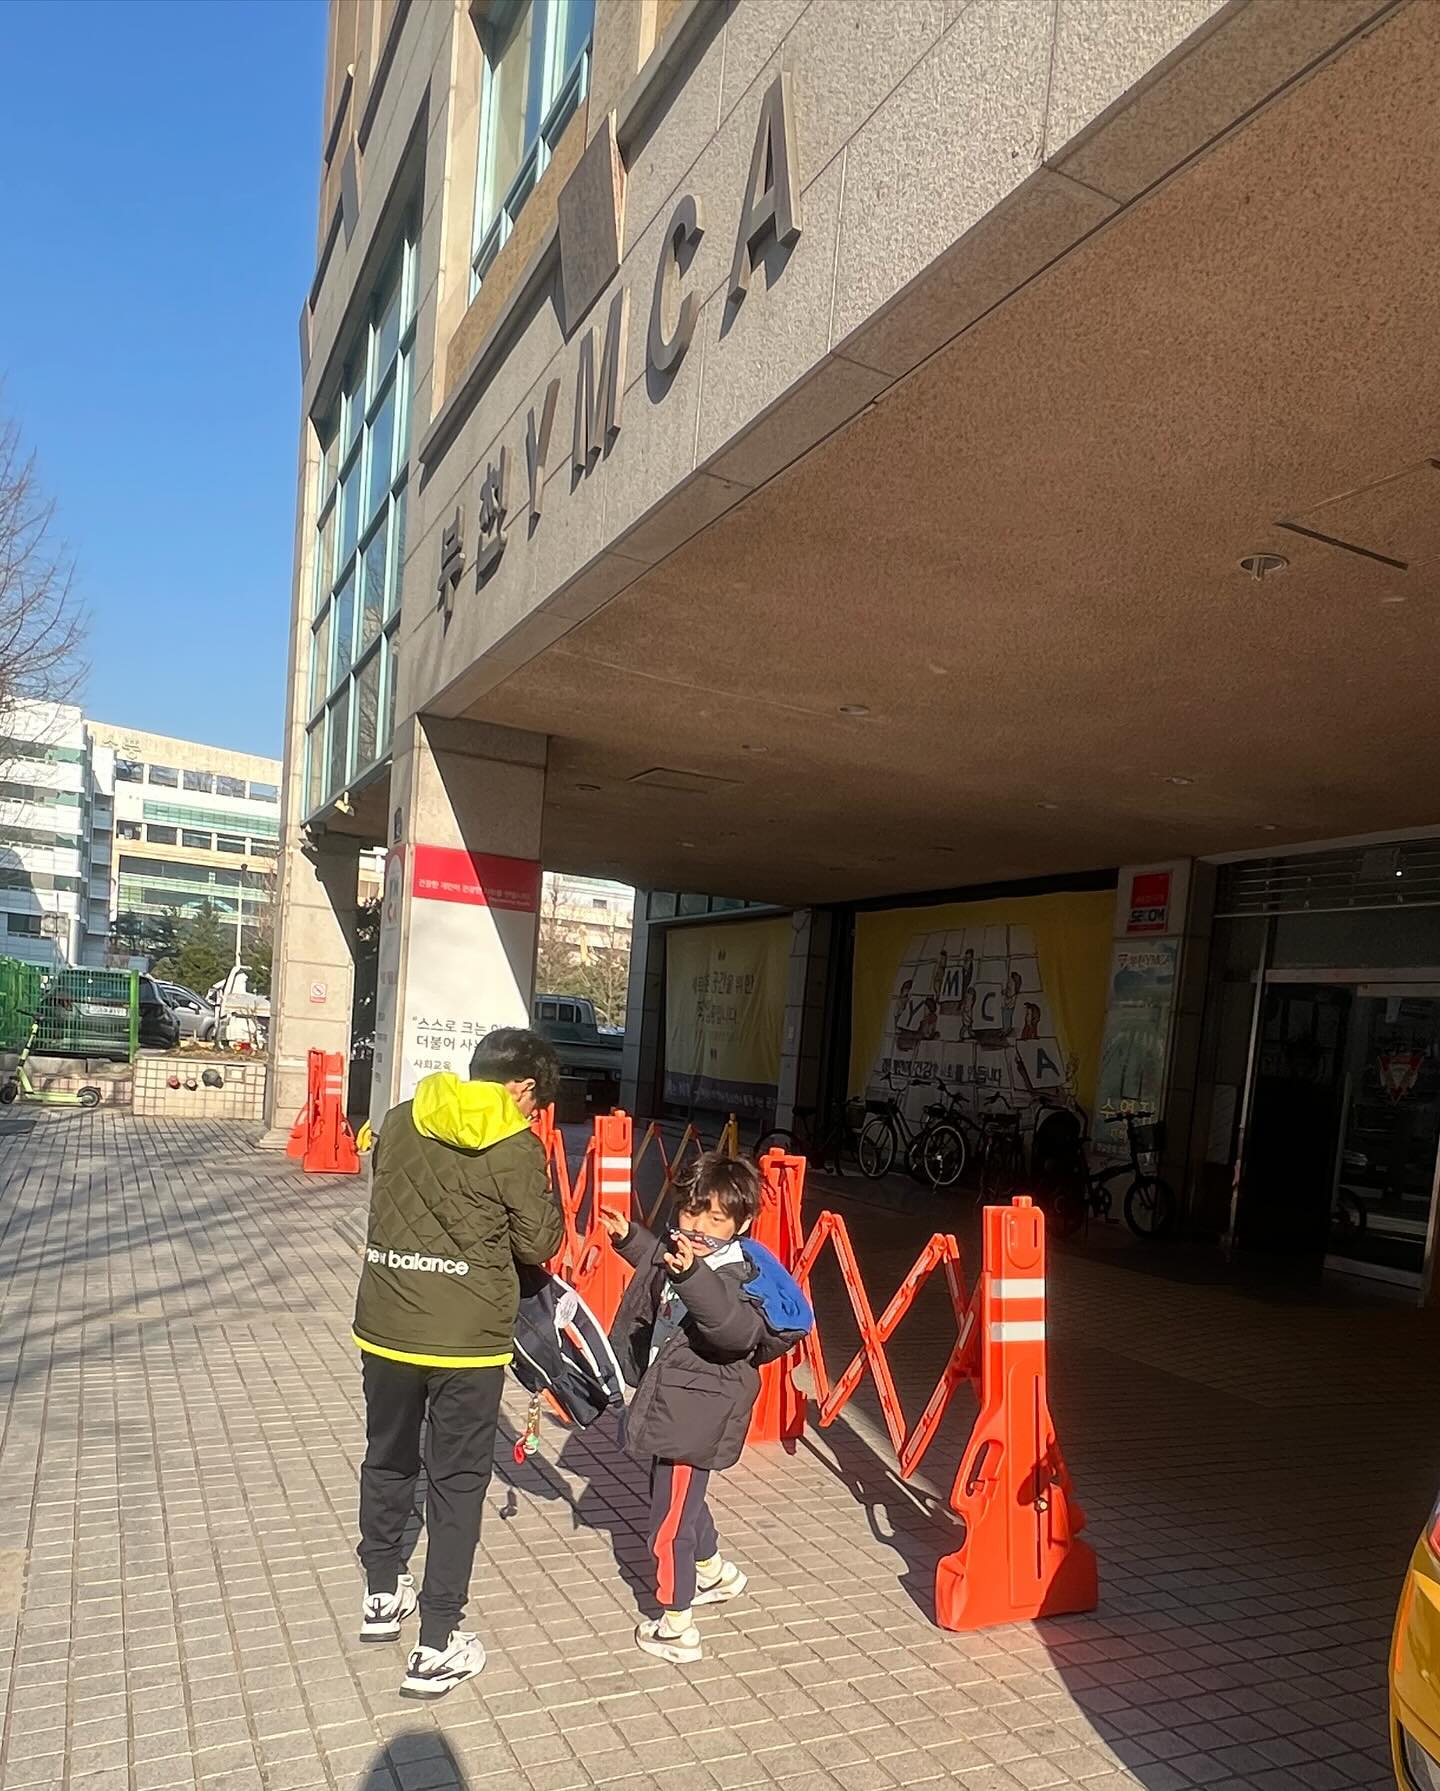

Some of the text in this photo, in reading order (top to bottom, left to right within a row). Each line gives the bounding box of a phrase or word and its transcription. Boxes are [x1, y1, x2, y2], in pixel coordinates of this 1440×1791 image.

[943, 970, 960, 997] M
[981, 992, 996, 1022] C
[1036, 1047, 1060, 1079] A
[416, 1034, 456, 1051] 더불어
[388, 1249, 470, 1276] balance
